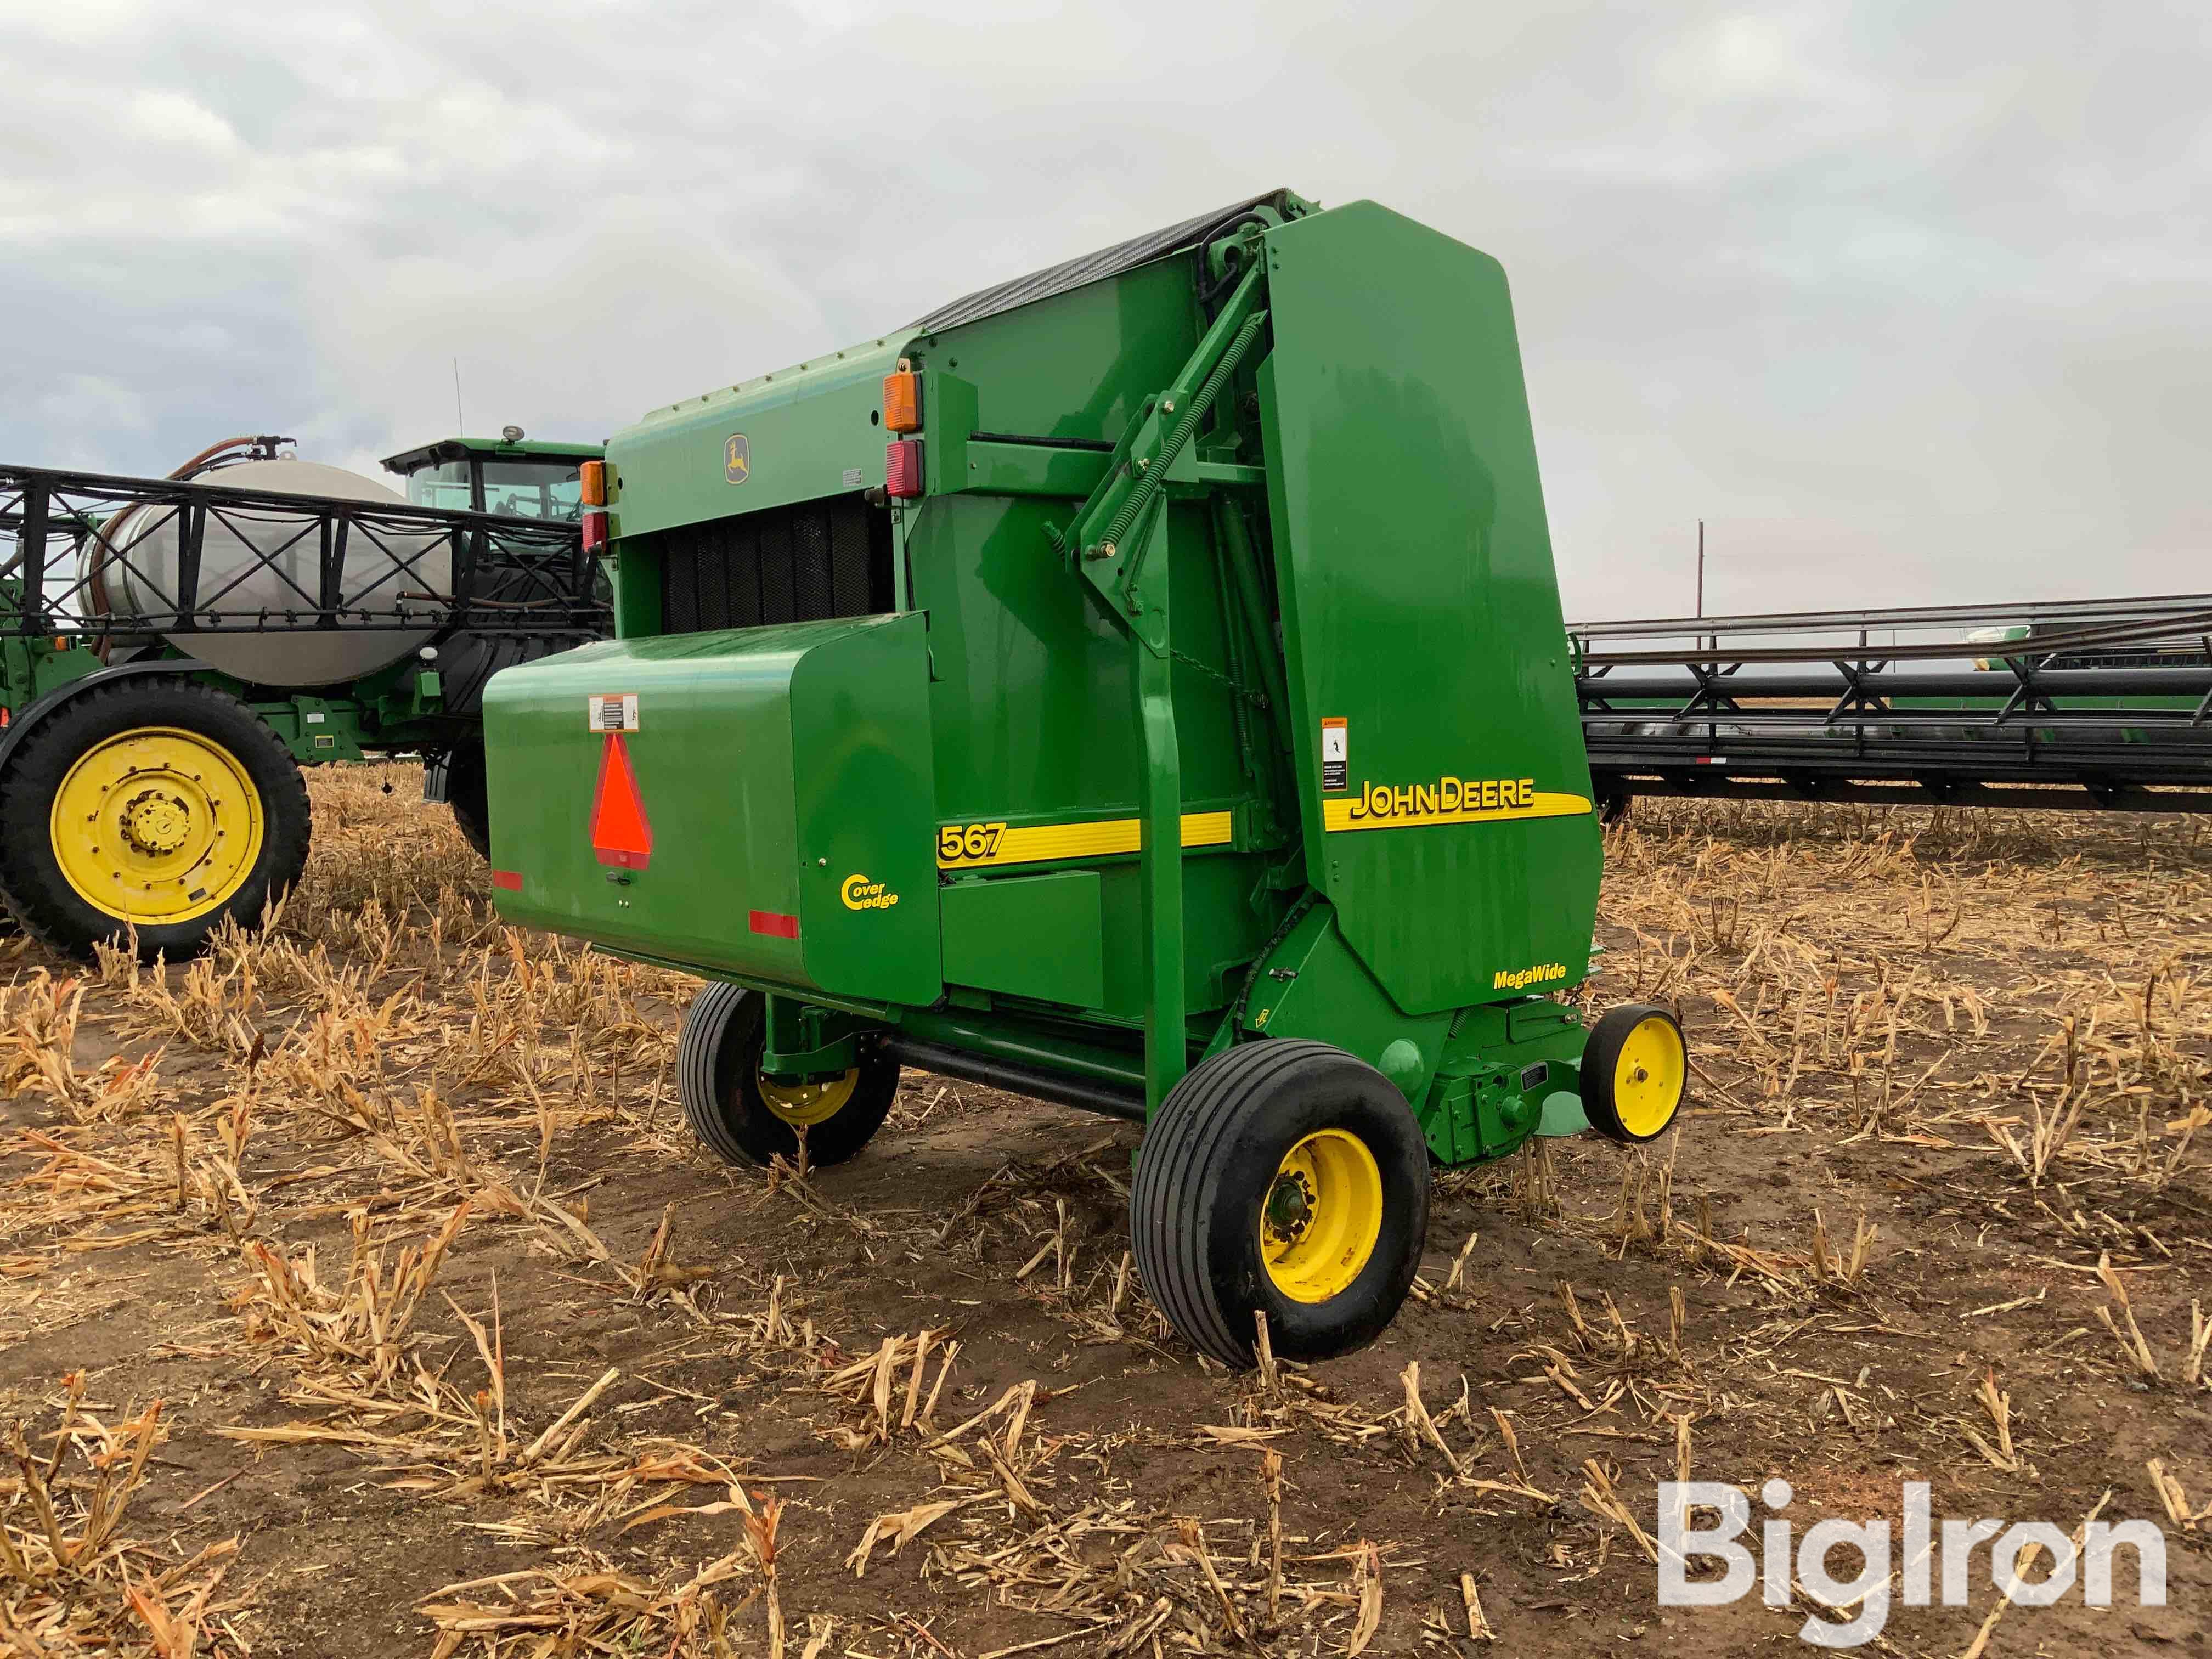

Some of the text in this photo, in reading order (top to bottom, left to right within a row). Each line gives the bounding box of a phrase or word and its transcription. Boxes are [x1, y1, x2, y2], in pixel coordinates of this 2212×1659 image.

[939, 822, 1007, 861] 567
[841, 874, 885, 911] Cover
[1493, 962, 1566, 990] MegaWide
